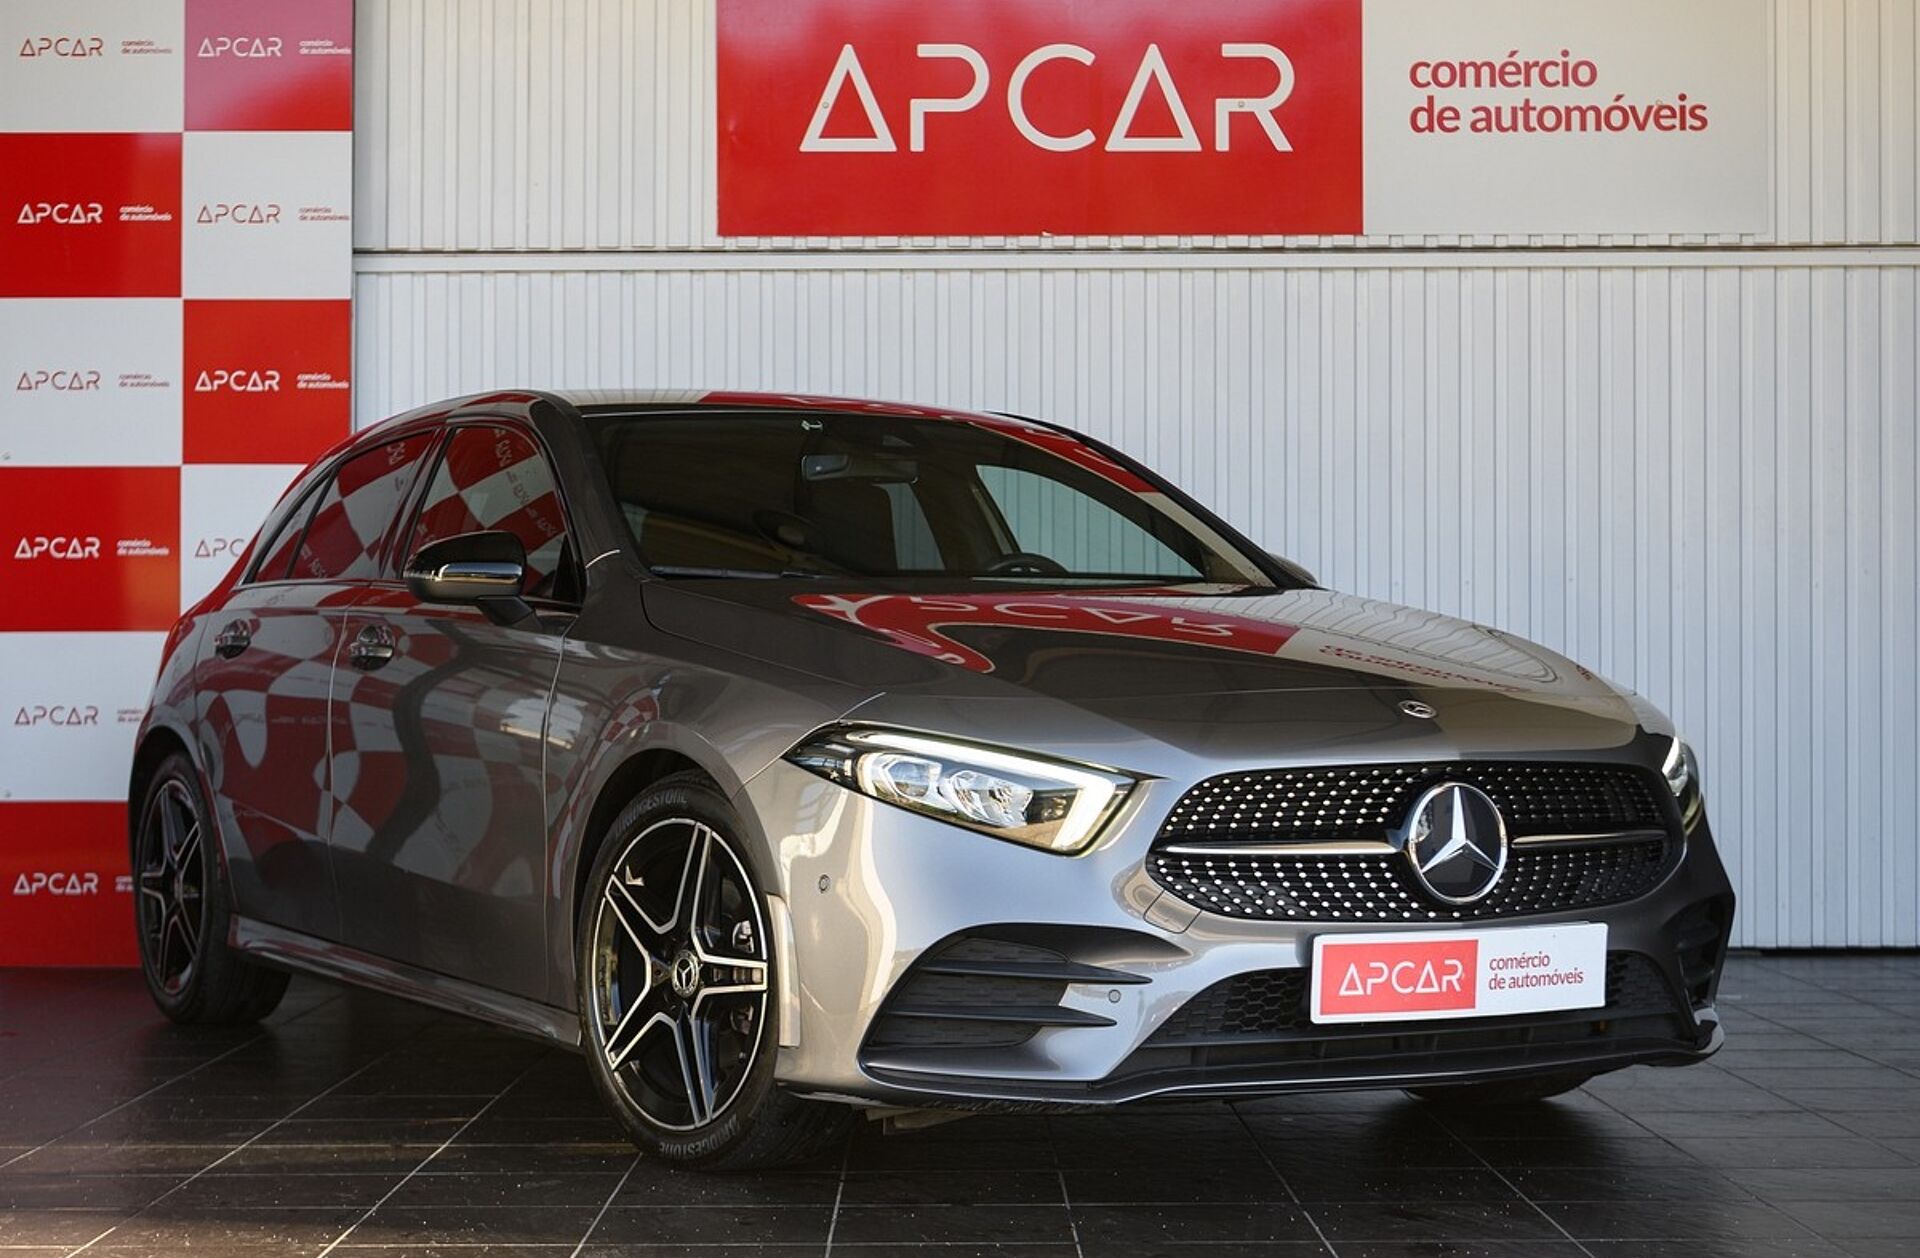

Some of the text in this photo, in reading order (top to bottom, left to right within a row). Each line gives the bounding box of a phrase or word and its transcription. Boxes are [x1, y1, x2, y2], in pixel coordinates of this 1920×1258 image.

[20, 38, 103, 57] APCAR
[198, 37, 282, 57] APCAR
[1409, 49, 1598, 88] comércio
[799, 43, 1295, 152] APCAR
[1409, 93, 1708, 133] de automóveis
[17, 203, 103, 224] APCAR
[197, 204, 281, 223] APCAR
[16, 371, 101, 391] APCAR
[194, 370, 281, 392] APCAR
[14, 537, 100, 559] APCAR
[195, 539, 244, 557] APC
[14, 706, 98, 725] APCAR
[13, 873, 98, 895] APCAR
[1489, 951, 1550, 971] comércio
[1338, 959, 1464, 996] APCAR
[1489, 966, 1584, 990] de automóveis
